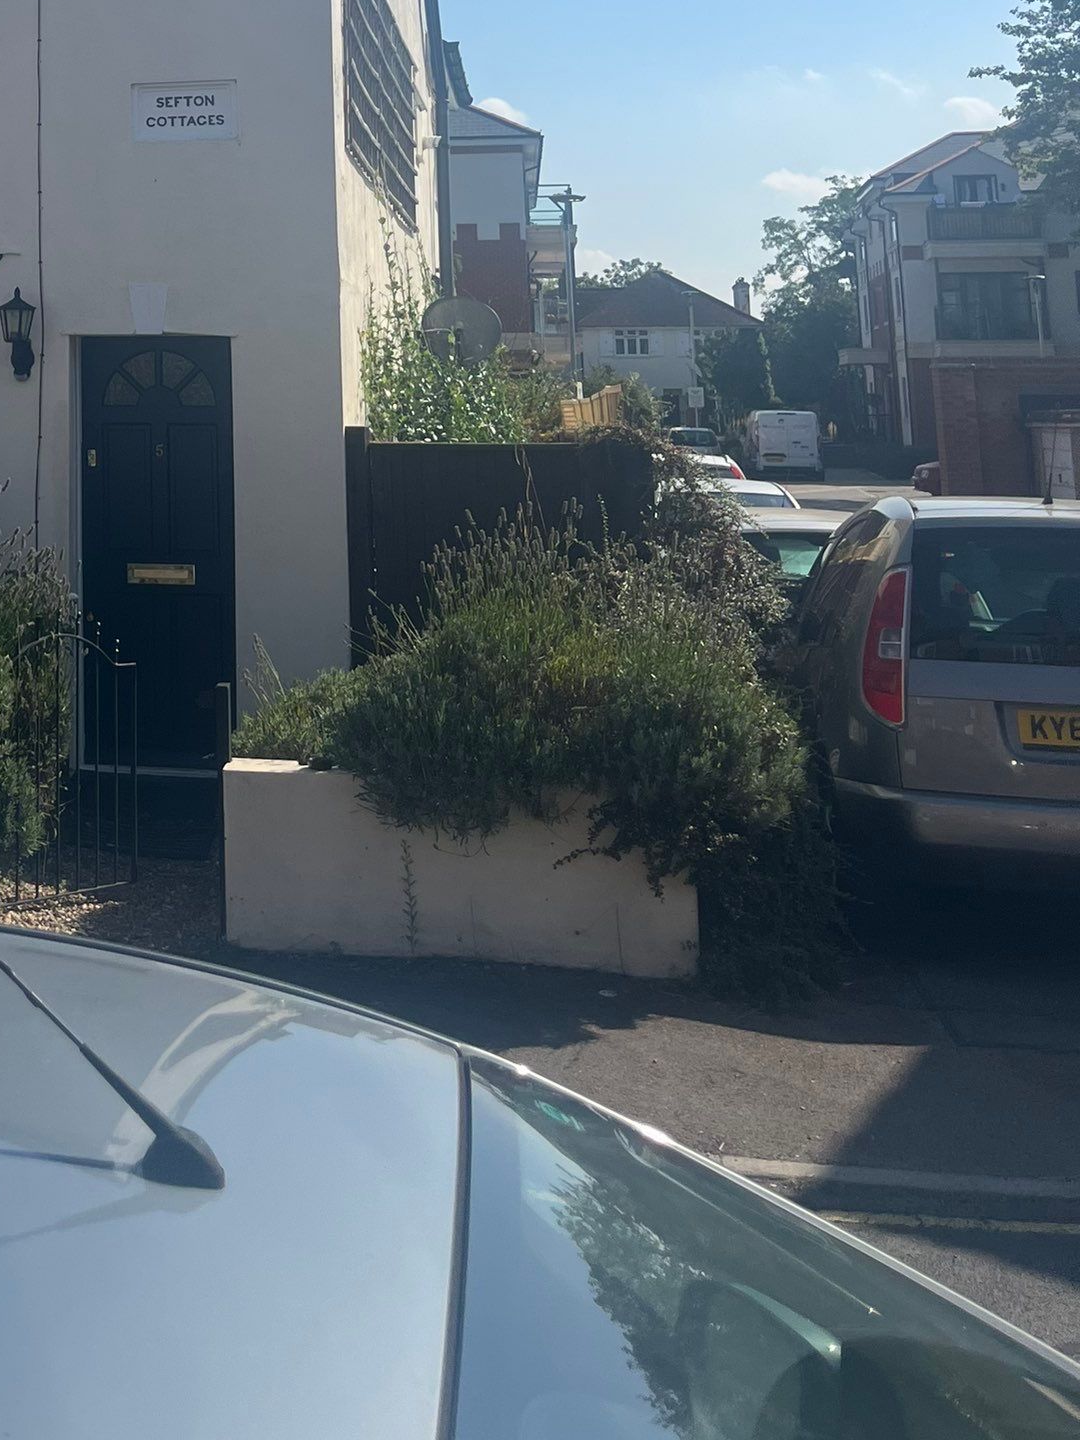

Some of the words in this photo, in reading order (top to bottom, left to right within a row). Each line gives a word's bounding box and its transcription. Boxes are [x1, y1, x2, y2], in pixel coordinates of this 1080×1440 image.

[156, 95, 215, 108] SEFTON
[146, 115, 225, 127] COTTAGES
[155, 443, 164, 456] 5
